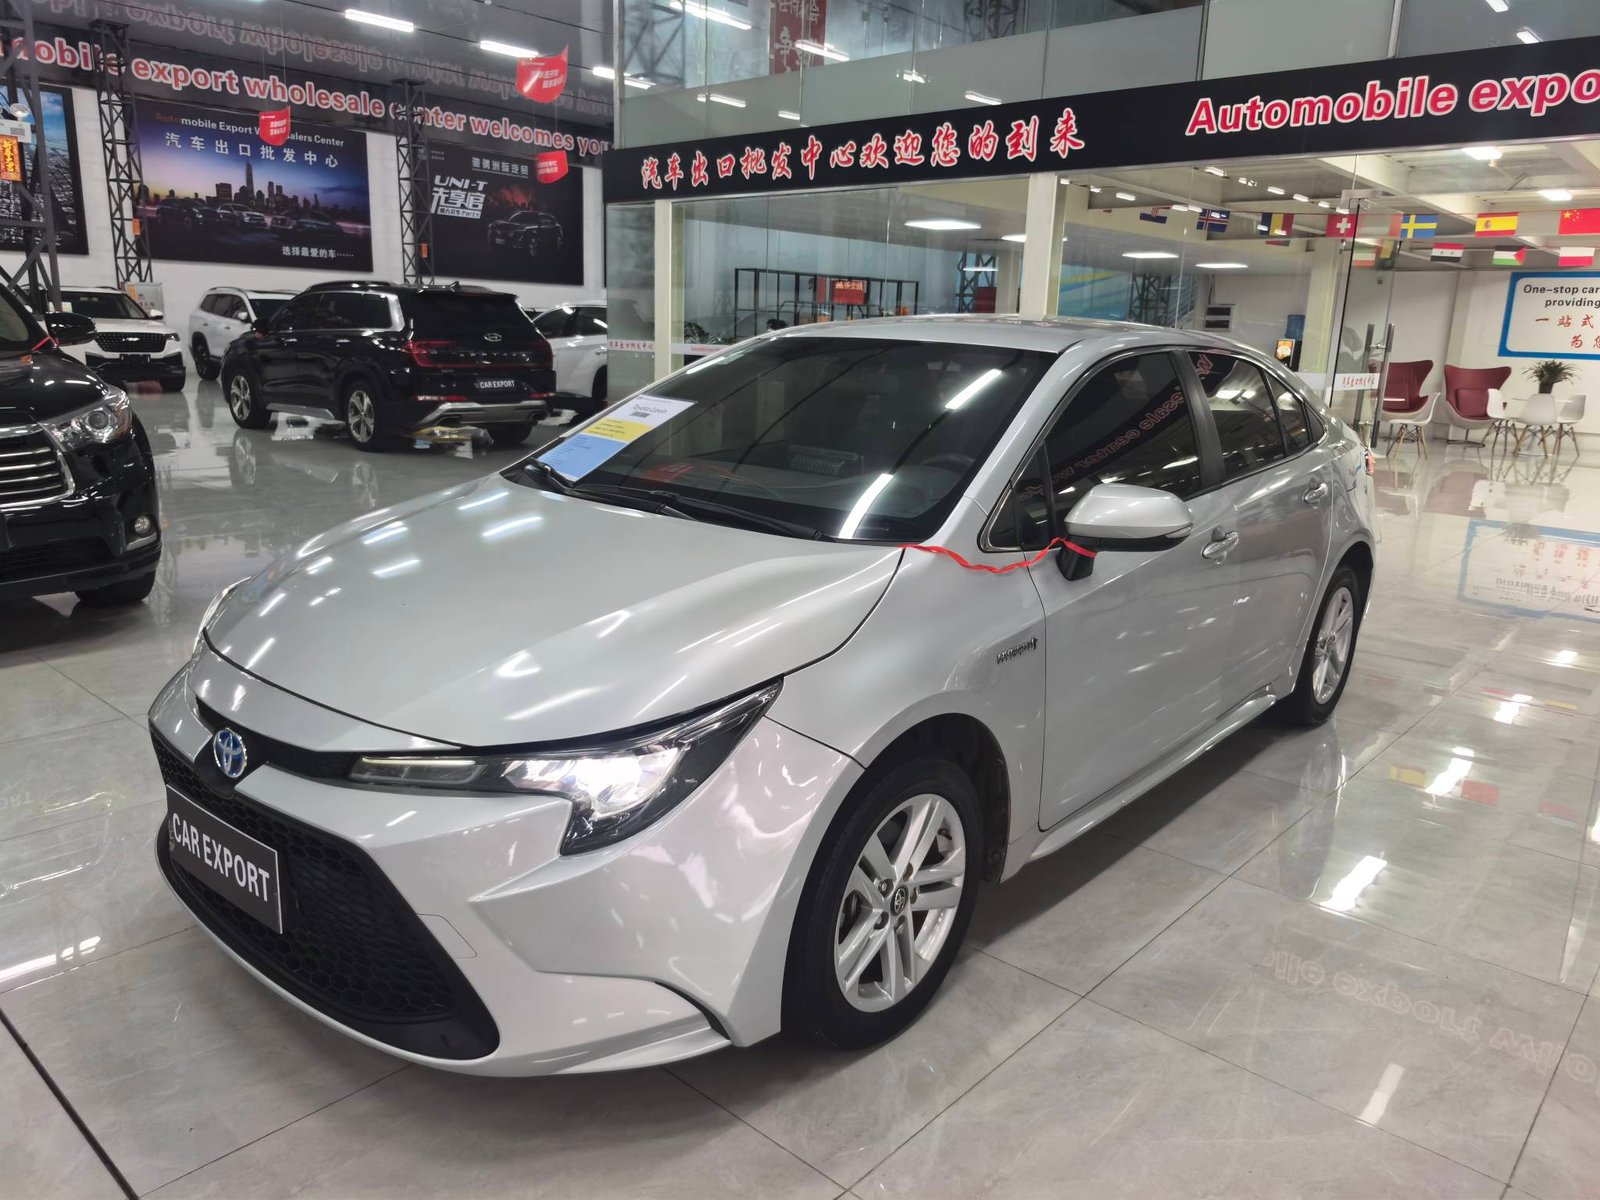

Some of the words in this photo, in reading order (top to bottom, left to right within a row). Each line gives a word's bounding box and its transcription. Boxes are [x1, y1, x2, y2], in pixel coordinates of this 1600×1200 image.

[131, 57, 239, 92] export
[243, 75, 385, 119] wholesale
[469, 115, 575, 151] welcomes
[1185, 75, 1458, 136] Automobile
[1468, 69, 1600, 117] expo
[165, 131, 339, 169] 汽车出口批发中心
[219, 121, 253, 134] Export
[314, 134, 345, 147] Center
[641, 107, 1085, 192] 汽车出口批发中心欢迎您的到来
[434, 174, 488, 192] UNI-T
[1523, 284, 1579, 295] One-stop
[1535, 313, 1594, 329] 一站式
[479, 380, 493, 389] CAR
[493, 379, 515, 389] EXPORT
[172, 812, 201, 860] CAR
[202, 832, 270, 903] EXPORT
